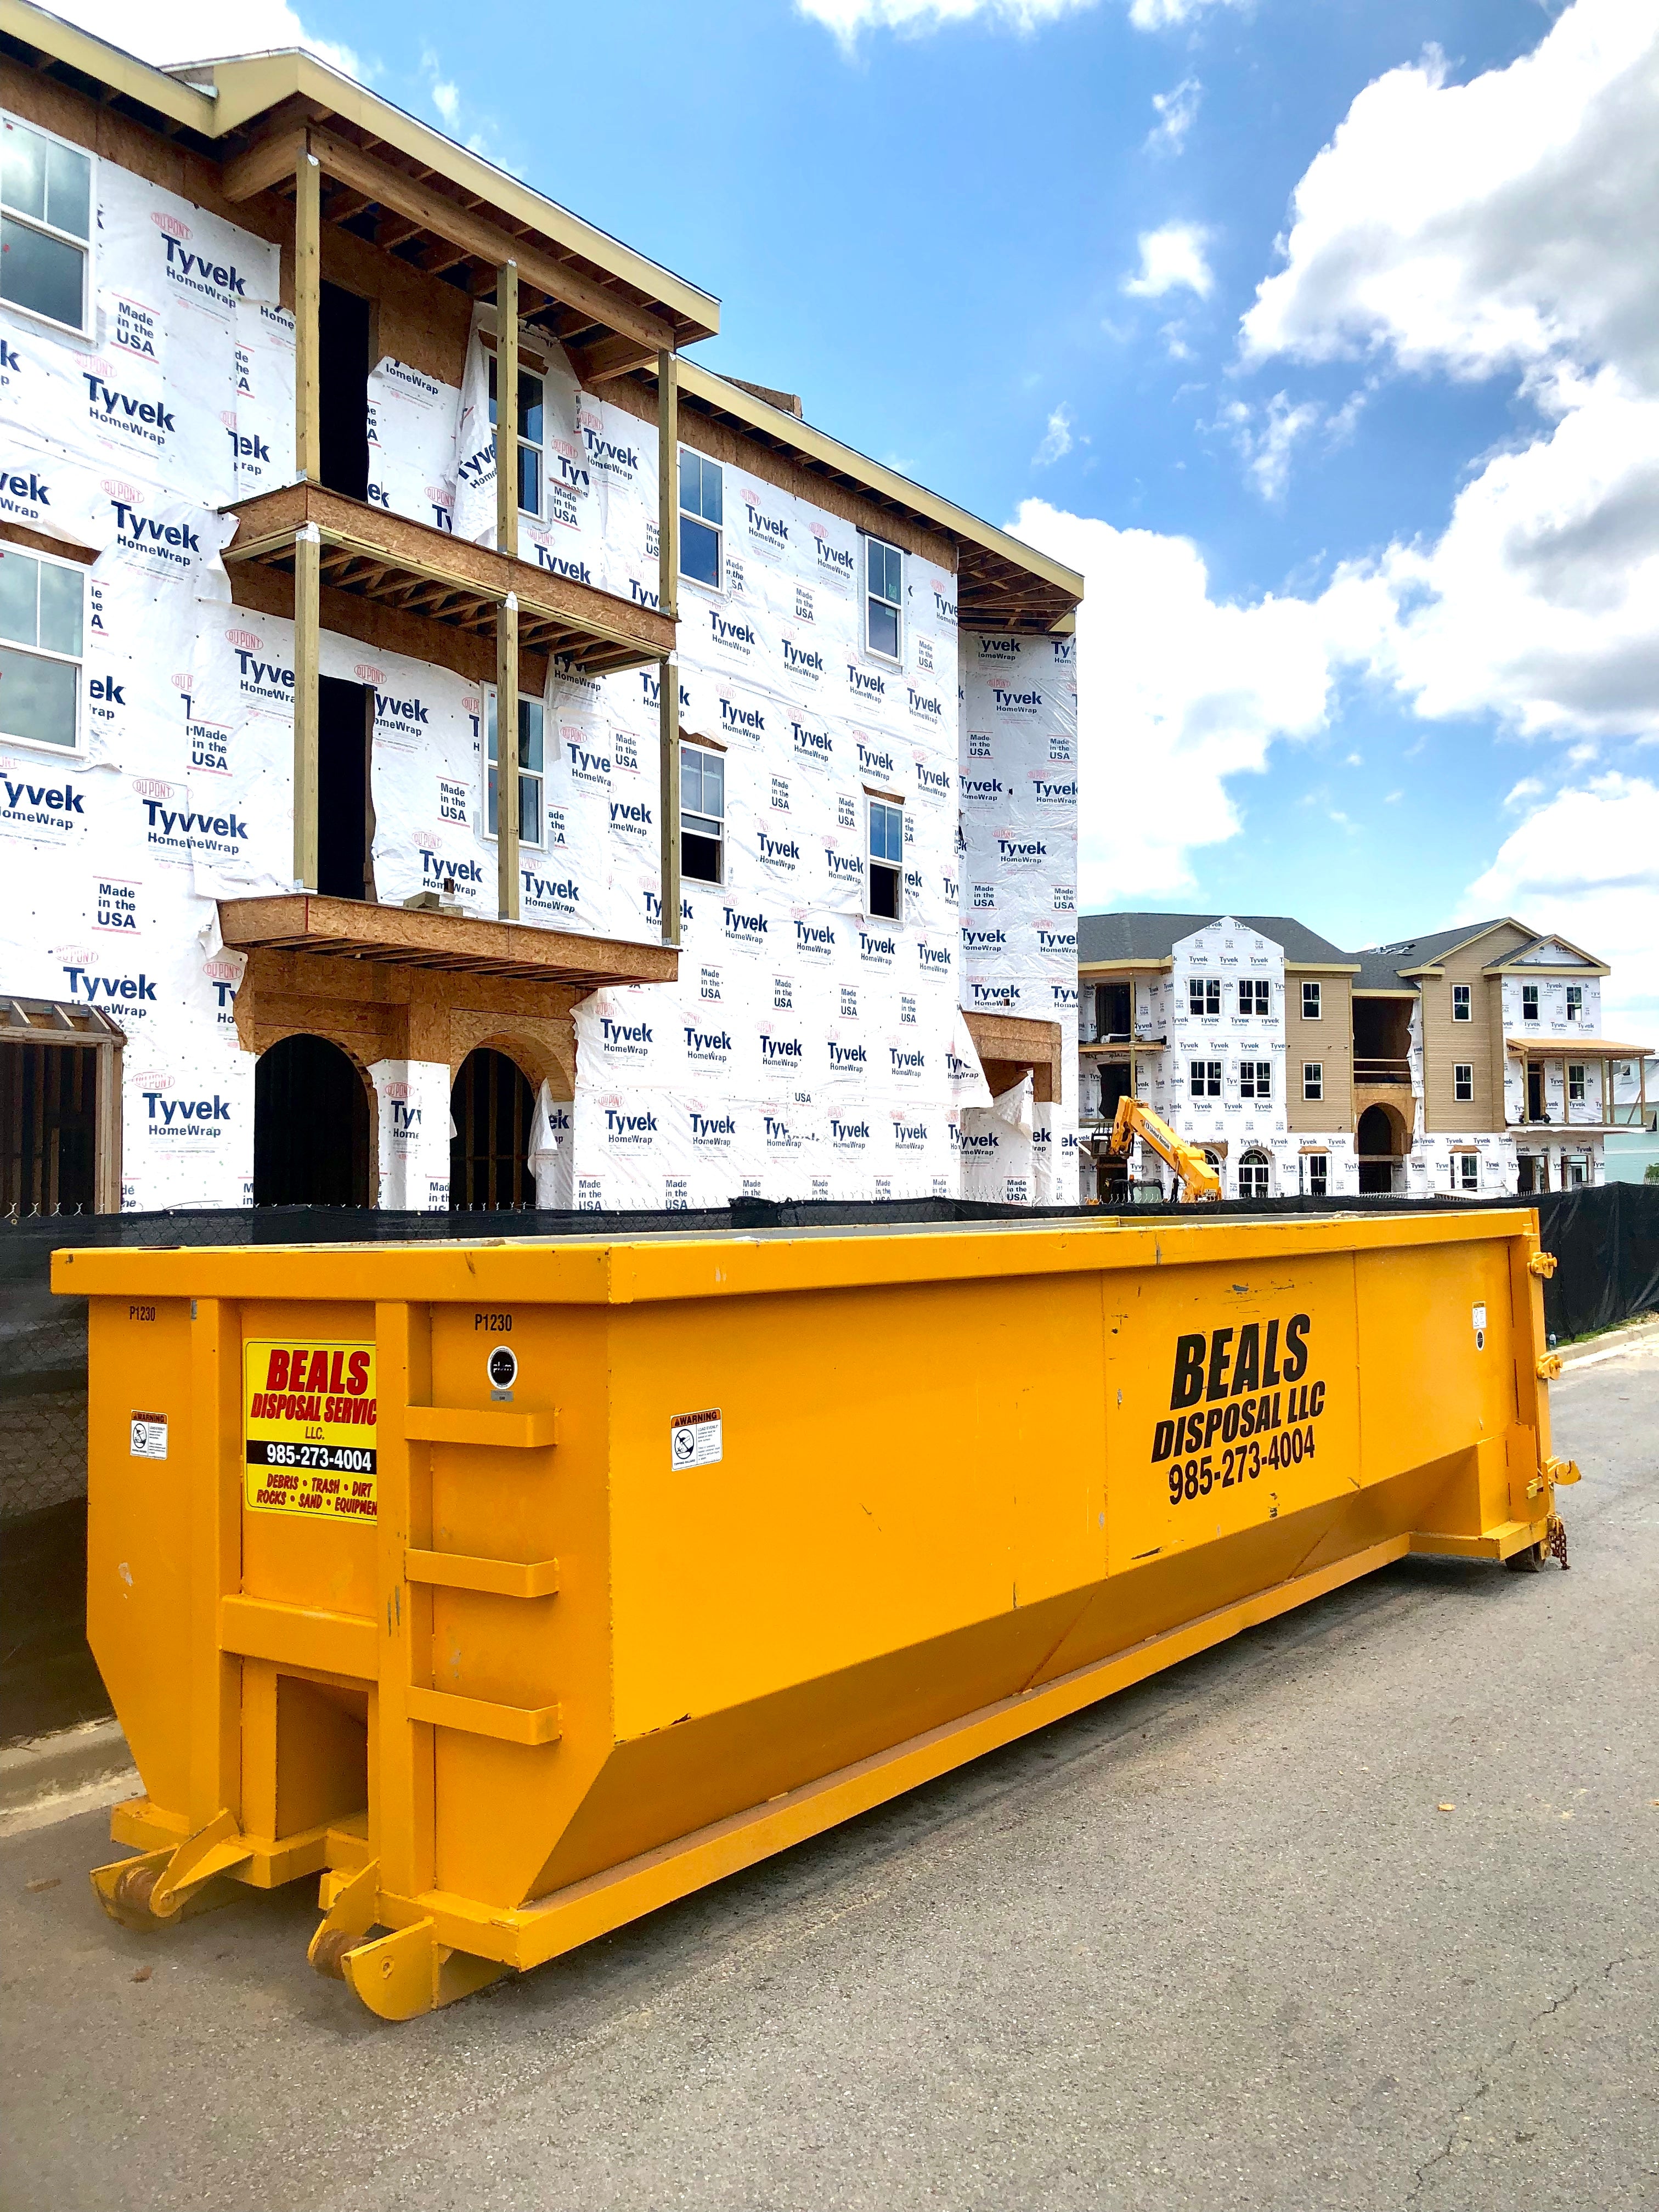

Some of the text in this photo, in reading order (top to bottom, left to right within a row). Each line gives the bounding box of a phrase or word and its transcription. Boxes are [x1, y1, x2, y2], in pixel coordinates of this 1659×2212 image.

[161, 233, 246, 300] Tyvek
[167, 266, 235, 308] HomeWrap
[118, 302, 153, 328] Made
[118, 314, 153, 338] in the
[117, 328, 155, 356] USA
[83, 373, 175, 432] Tyvek
[90, 404, 165, 445] HomeWrap
[584, 428, 639, 470] Tyvek
[554, 486, 576, 504] Made
[554, 506, 577, 526] USA
[746, 504, 788, 541] Tyvek
[111, 500, 199, 554] Tyvek
[749, 527, 784, 549] HomeWrap
[117, 534, 190, 566] HomeWrap
[814, 536, 854, 571] Tyvek
[534, 544, 591, 585] Tyvek
[818, 558, 850, 579] HomeWrap
[797, 588, 812, 600] Made
[796, 606, 813, 620] USA
[709, 610, 755, 646] Tyvek
[713, 634, 750, 655] HomeWrap
[782, 639, 823, 673] Tyvek
[554, 667, 600, 691] HomeWrap
[785, 662, 819, 681] HomeWrap
[847, 664, 884, 697] Tyvek
[850, 686, 881, 703] HomeWrap
[907, 687, 941, 718] Tyvek
[993, 689, 1042, 706] Tyvek
[720, 698, 764, 733] Tyvek
[997, 706, 1037, 714] HomeWrap
[193, 726, 227, 741] Made
[616, 733, 636, 746] Made
[723, 722, 760, 741] HomeWrap
[791, 722, 832, 753] Tyvek
[193, 741, 227, 753] in the
[795, 744, 828, 762] HomeWrap
[970, 748, 990, 758] USA
[193, 752, 228, 770] USA
[616, 754, 637, 769] USA
[857, 744, 893, 773] Tyvek
[860, 765, 889, 781] HomeWrap
[916, 763, 950, 789] Tyvek
[441, 783, 465, 797] Made
[772, 778, 788, 789] Made
[918, 783, 946, 798] HomeWrap
[452, 797, 465, 807] the
[772, 797, 789, 809] USA
[839, 798, 854, 808] Made
[441, 805, 466, 822] USA
[839, 815, 855, 827] USA
[757, 833, 799, 859] Tyvek
[998, 840, 1046, 856] Tyvek
[420, 849, 482, 882] Tyvek
[760, 855, 795, 871] HomeWrap
[825, 849, 864, 874] Tyvek
[521, 871, 579, 901] Tyvek
[829, 871, 861, 885] HomeWrap
[99, 884, 134, 898] Made
[526, 896, 574, 913] HomeWrap
[98, 911, 136, 928] USA
[723, 907, 768, 933] Tyvek
[794, 921, 835, 944] Tyvek
[797, 943, 831, 956] HomeWrap
[859, 933, 895, 954] Tyvek
[917, 943, 950, 964] Tyvek
[702, 968, 719, 978] Made
[920, 963, 947, 974] HomeWrap
[63, 967, 157, 1001] Tyvek
[702, 988, 720, 998] USA
[775, 979, 791, 988] Made
[971, 984, 1020, 1000] Tyvek
[775, 997, 792, 1008] USA
[600, 1018, 653, 1043] Tyvek
[684, 1028, 731, 1051] Tyvek
[605, 1043, 647, 1056] HomeWrap
[760, 1035, 802, 1058] Tyvek
[828, 1042, 867, 1063] Tyvek
[688, 1051, 726, 1063] HomeWrap
[763, 1058, 798, 1068] HomeWrap
[889, 1048, 924, 1068] Tyvek
[831, 1062, 862, 1073] HomeWrap
[142, 1093, 230, 1125] Tyvek
[149, 1125, 221, 1138] HomeWrap
[605, 1110, 657, 1135] Tyvek
[690, 1114, 735, 1137] Tyvek
[831, 1120, 869, 1141] Tyvek
[893, 1122, 927, 1142] Tyvek
[609, 1135, 652, 1145] HomeWrap
[693, 1137, 730, 1147] HomeWrap
[768, 1139, 801, 1148] HomeWrap
[129, 1306, 155, 1322] P1230
[475, 1313, 512, 1331] P1230
[266, 1349, 370, 1395] BEALS
[1170, 1314, 1311, 1410] BEALS
[251, 1393, 321, 1422] DISPOSAL
[680, 1411, 717, 1425] WARNING
[1151, 1381, 1325, 1463] DISPOSAL LLC
[306, 1426, 325, 1440] LLC.
[267, 1444, 371, 1471] 985-273-4004
[1169, 1425, 1315, 1505] 985-273-4004
[267, 1474, 373, 1498] DEBRIS TRASH DIRT
[257, 1489, 286, 1505] ROCKS
[298, 1493, 323, 1509] SAND
